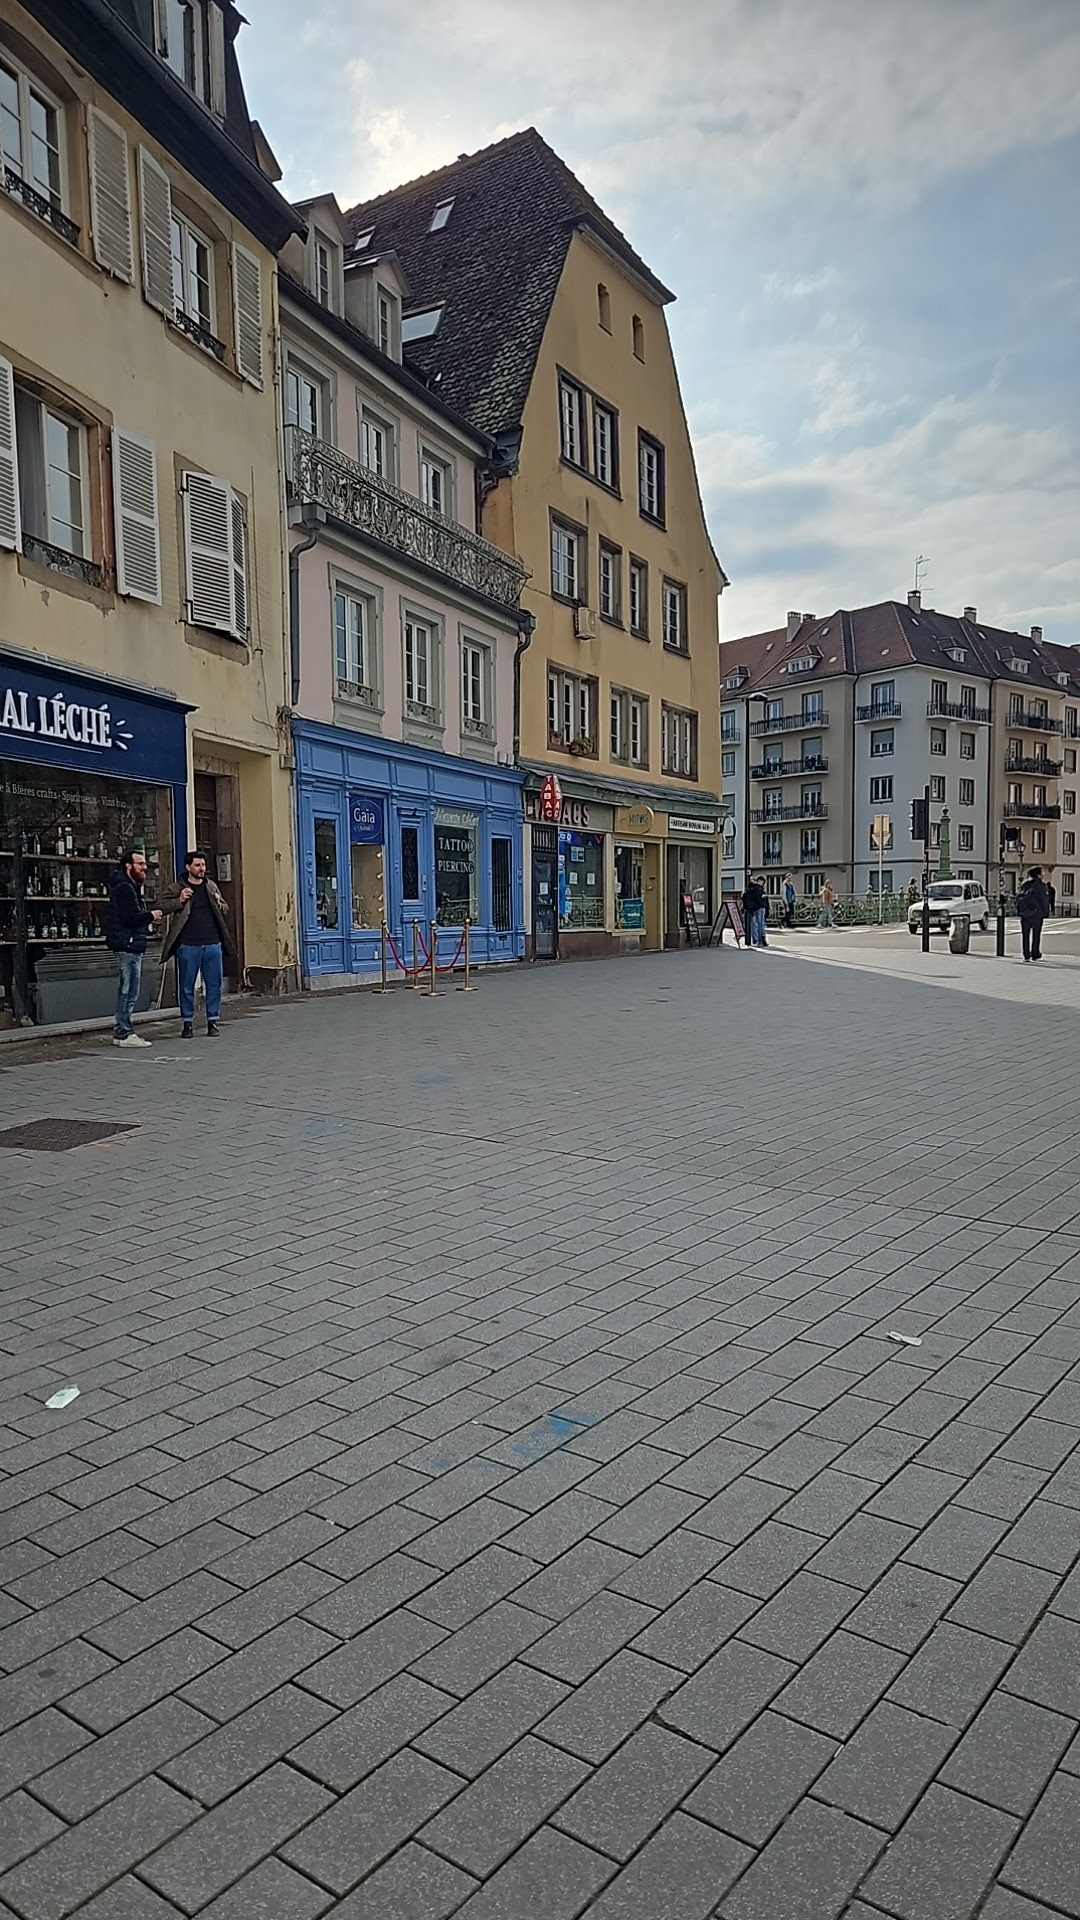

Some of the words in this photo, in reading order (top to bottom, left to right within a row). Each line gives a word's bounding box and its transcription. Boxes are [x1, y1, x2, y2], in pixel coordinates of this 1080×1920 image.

[0, 689, 35, 732] AL
[37, 692, 112, 748] LÉCHÉ
[12, 784, 36, 797] Bières
[36, 788, 57, 800] crafts
[544, 775, 553, 818] TABAC
[438, 837, 474, 852] TATTOO
[438, 860, 474, 874] PIERCING
